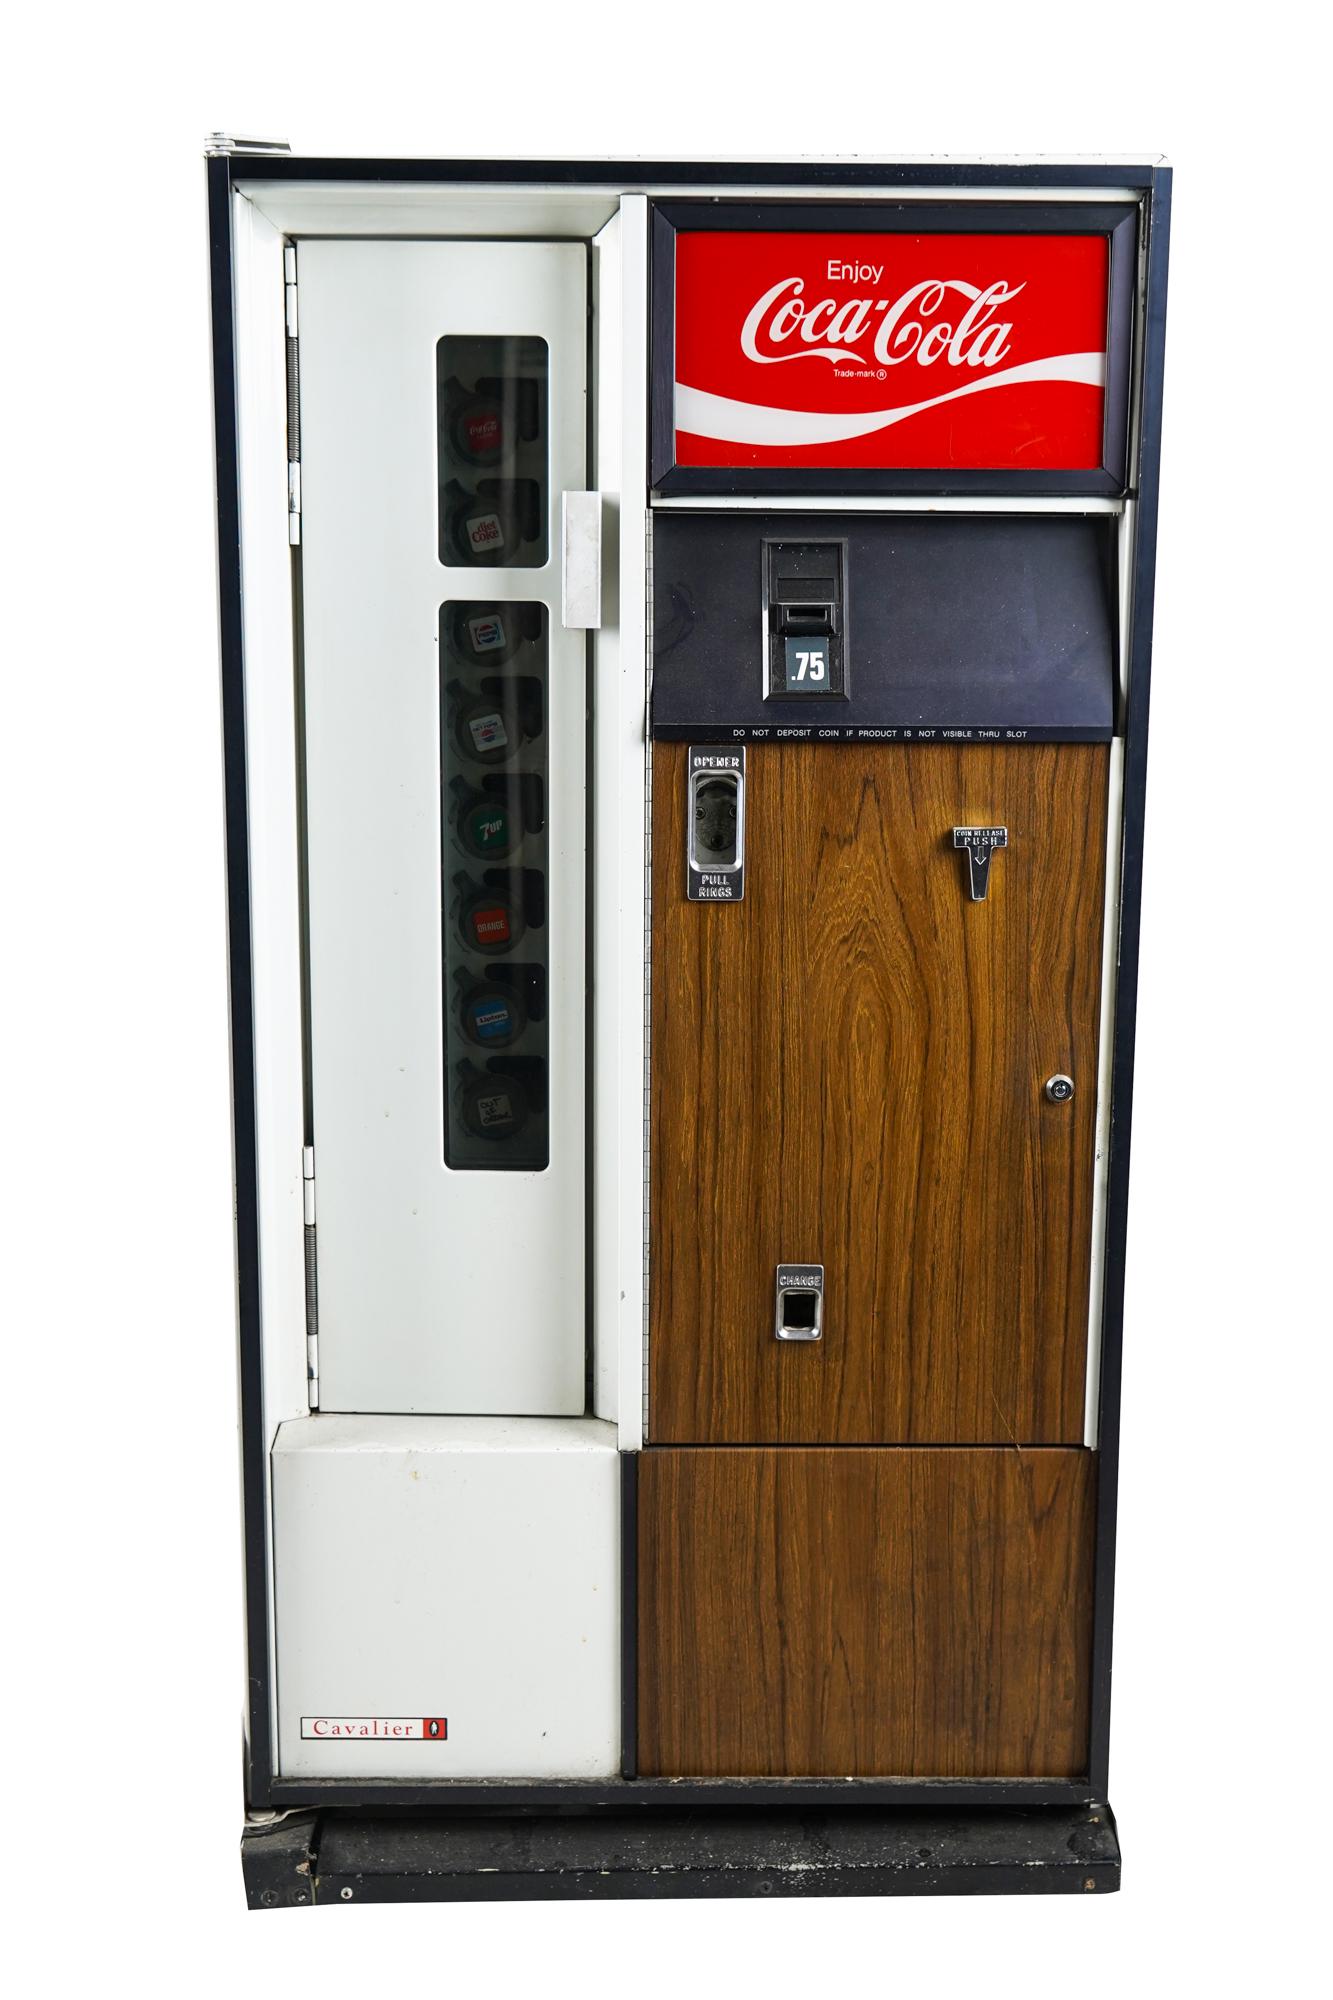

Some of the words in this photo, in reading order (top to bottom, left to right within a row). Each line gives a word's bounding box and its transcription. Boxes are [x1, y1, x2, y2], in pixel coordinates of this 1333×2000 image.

[827, 259, 884, 285] Enjoy
[740, 277, 1028, 368] Coca-Cola
[478, 520, 497, 531] diet
[472, 528, 499, 543] Coke
[791, 651, 825, 681] .75
[733, 729, 746, 737] DO
[752, 729, 770, 737] NOT
[777, 729, 812, 737] DEPOSIT
[818, 729, 840, 737] COIN
[846, 729, 854, 737] IF
[858, 730, 897, 738] PRODUCT
[904, 730, 912, 738] IS
[918, 730, 936, 738] NOT
[942, 730, 972, 738] VISIBLE
[978, 730, 1000, 738] THRU
[1006, 730, 1028, 738] SLOT
[693, 756, 740, 767] OPENER
[964, 837, 998, 846] PUSH
[701, 874, 730, 885] PULL
[698, 887, 733, 898] RINGS
[780, 1275, 822, 1287] CHANGE
[313, 1720, 413, 1735] Cavalier
